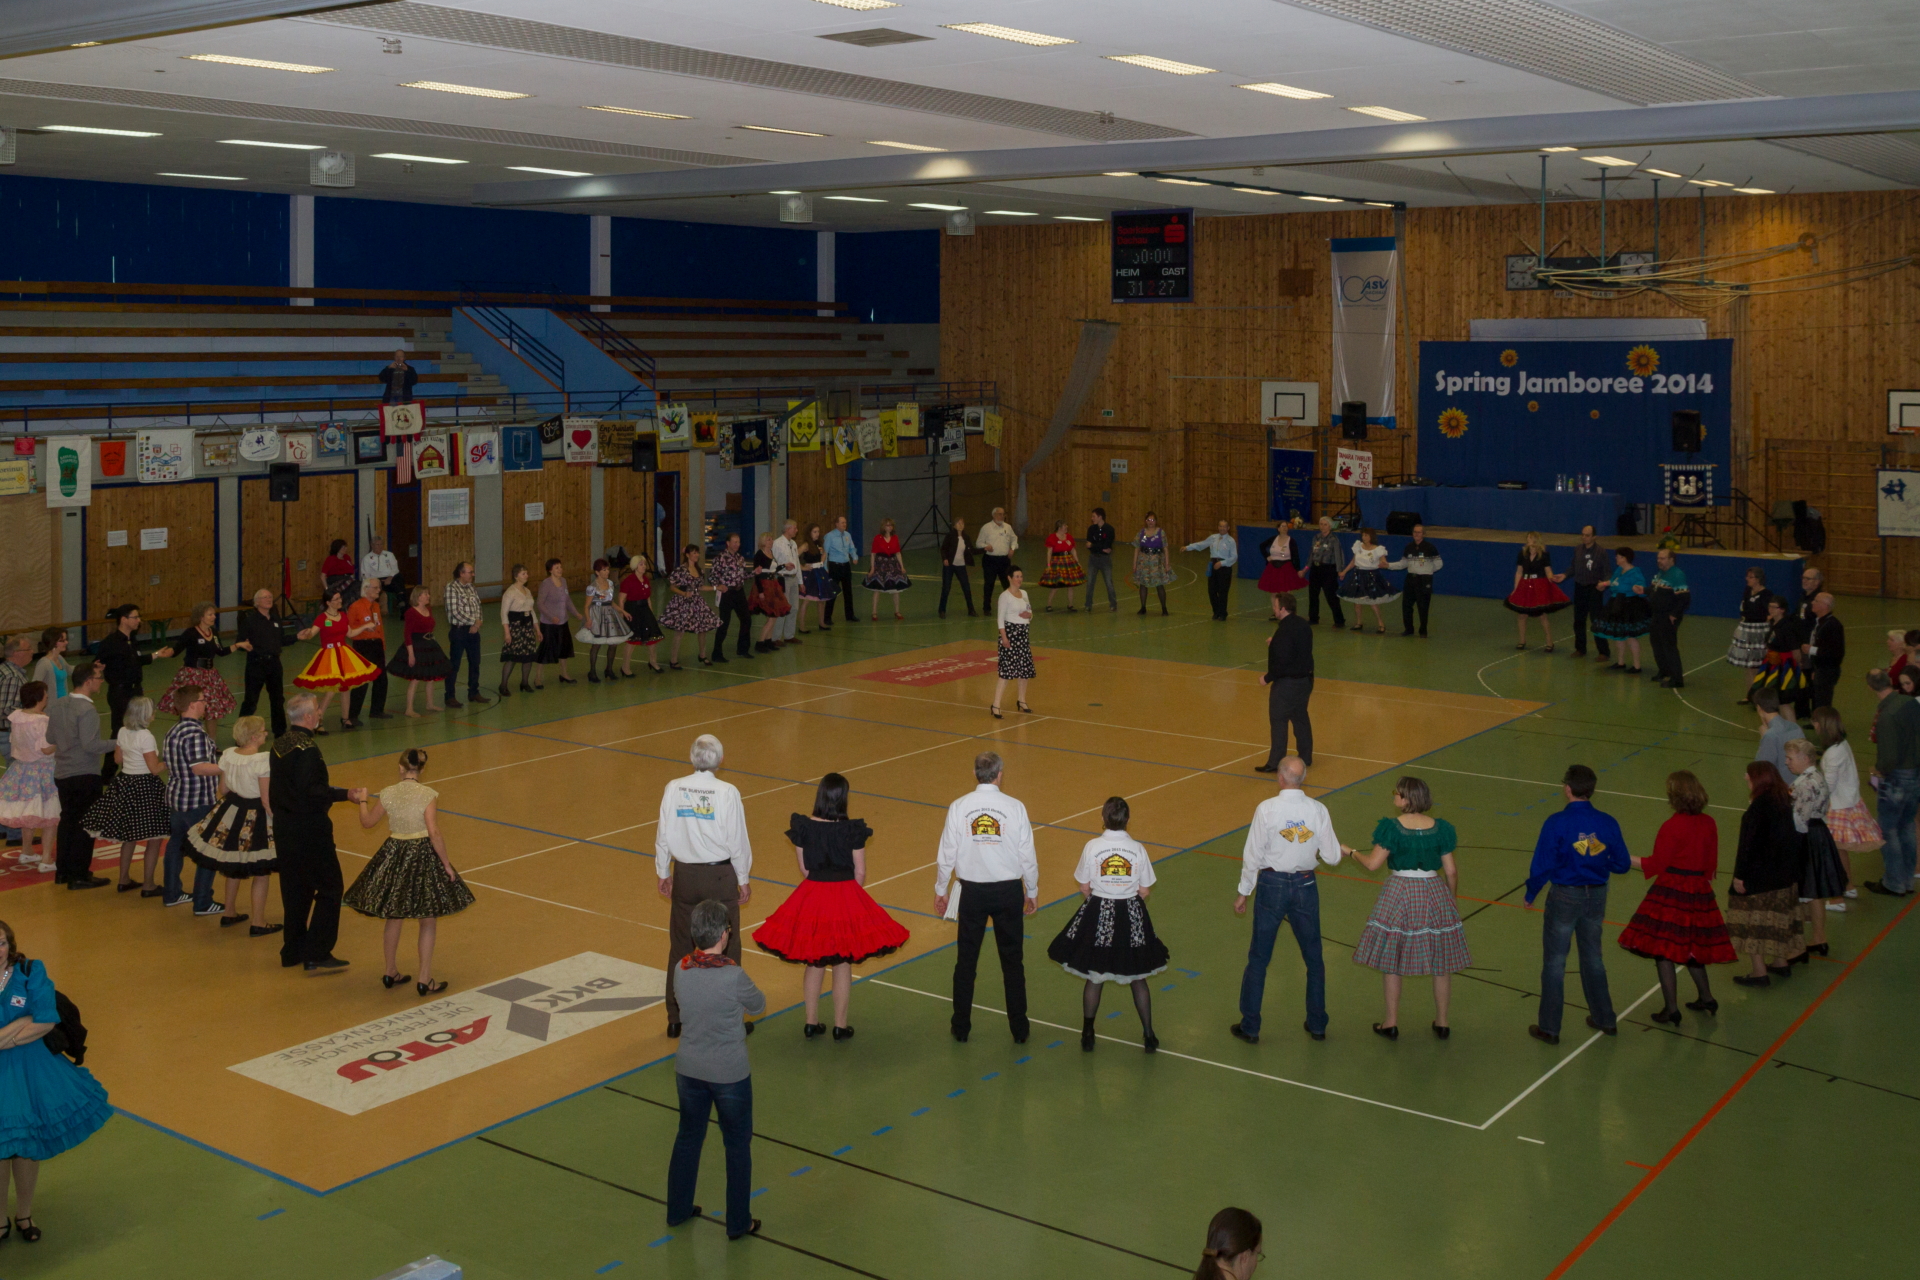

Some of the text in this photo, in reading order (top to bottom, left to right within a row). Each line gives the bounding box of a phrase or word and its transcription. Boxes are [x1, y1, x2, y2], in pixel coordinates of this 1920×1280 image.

[1117, 226, 1160, 236] Sparkasse
[1117, 237, 1148, 245] Dachau
[1116, 267, 1186, 277] HEIM GAST
[1128, 280, 1175, 296] 31 2 27
[1360, 279, 1389, 294] ASV
[1435, 370, 1713, 396] Spring Jamboree 2014
[530, 977, 622, 1009] BKK
[274, 1001, 456, 1061] KRANKENKASSE
[293, 1005, 474, 1068] DIE PERSÖNLICHE
